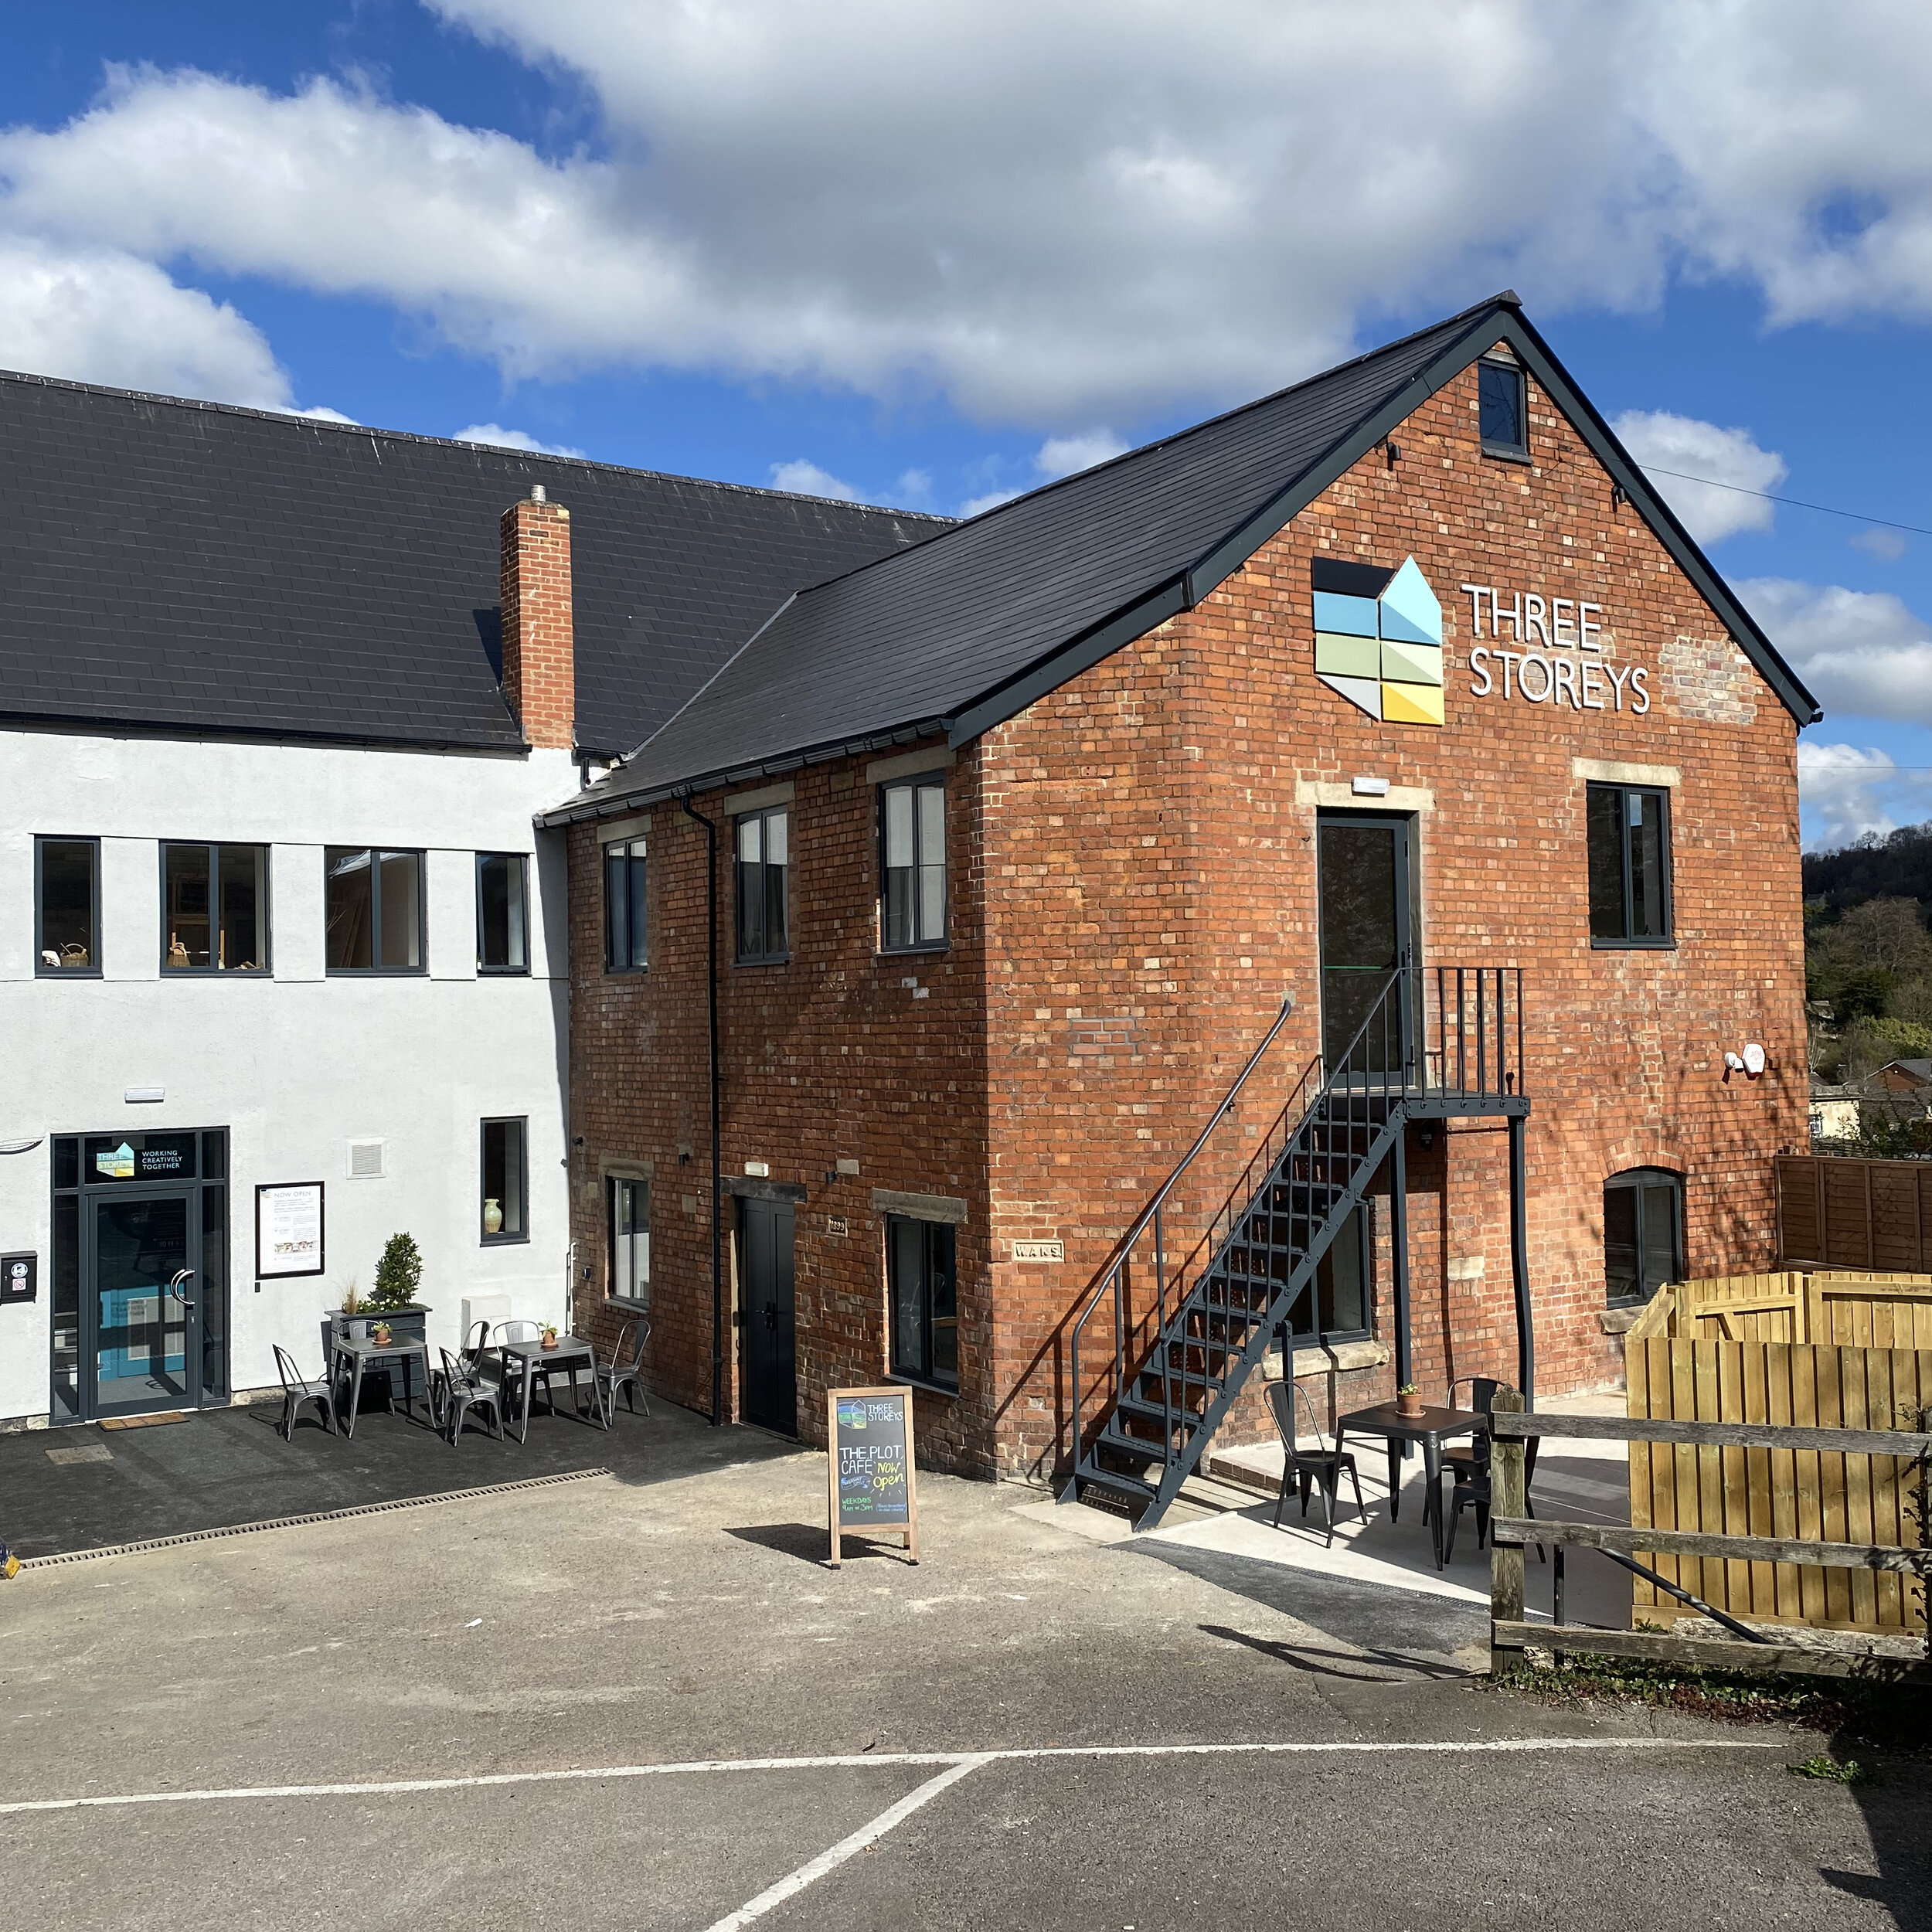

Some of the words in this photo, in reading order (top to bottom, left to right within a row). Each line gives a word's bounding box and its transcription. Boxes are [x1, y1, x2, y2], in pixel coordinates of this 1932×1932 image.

[1461, 583, 1603, 652] THREE
[1470, 646, 1651, 714] STOREYS
[867, 1403, 894, 1413] THREE
[868, 1412, 903, 1422] STOREYS
[839, 1447, 866, 1460] THE
[869, 1444, 903, 1459] PLOT
[842, 1458, 873, 1475] CAFÉ
[877, 1461, 901, 1474] NOW
[873, 1473, 904, 1491] Open
